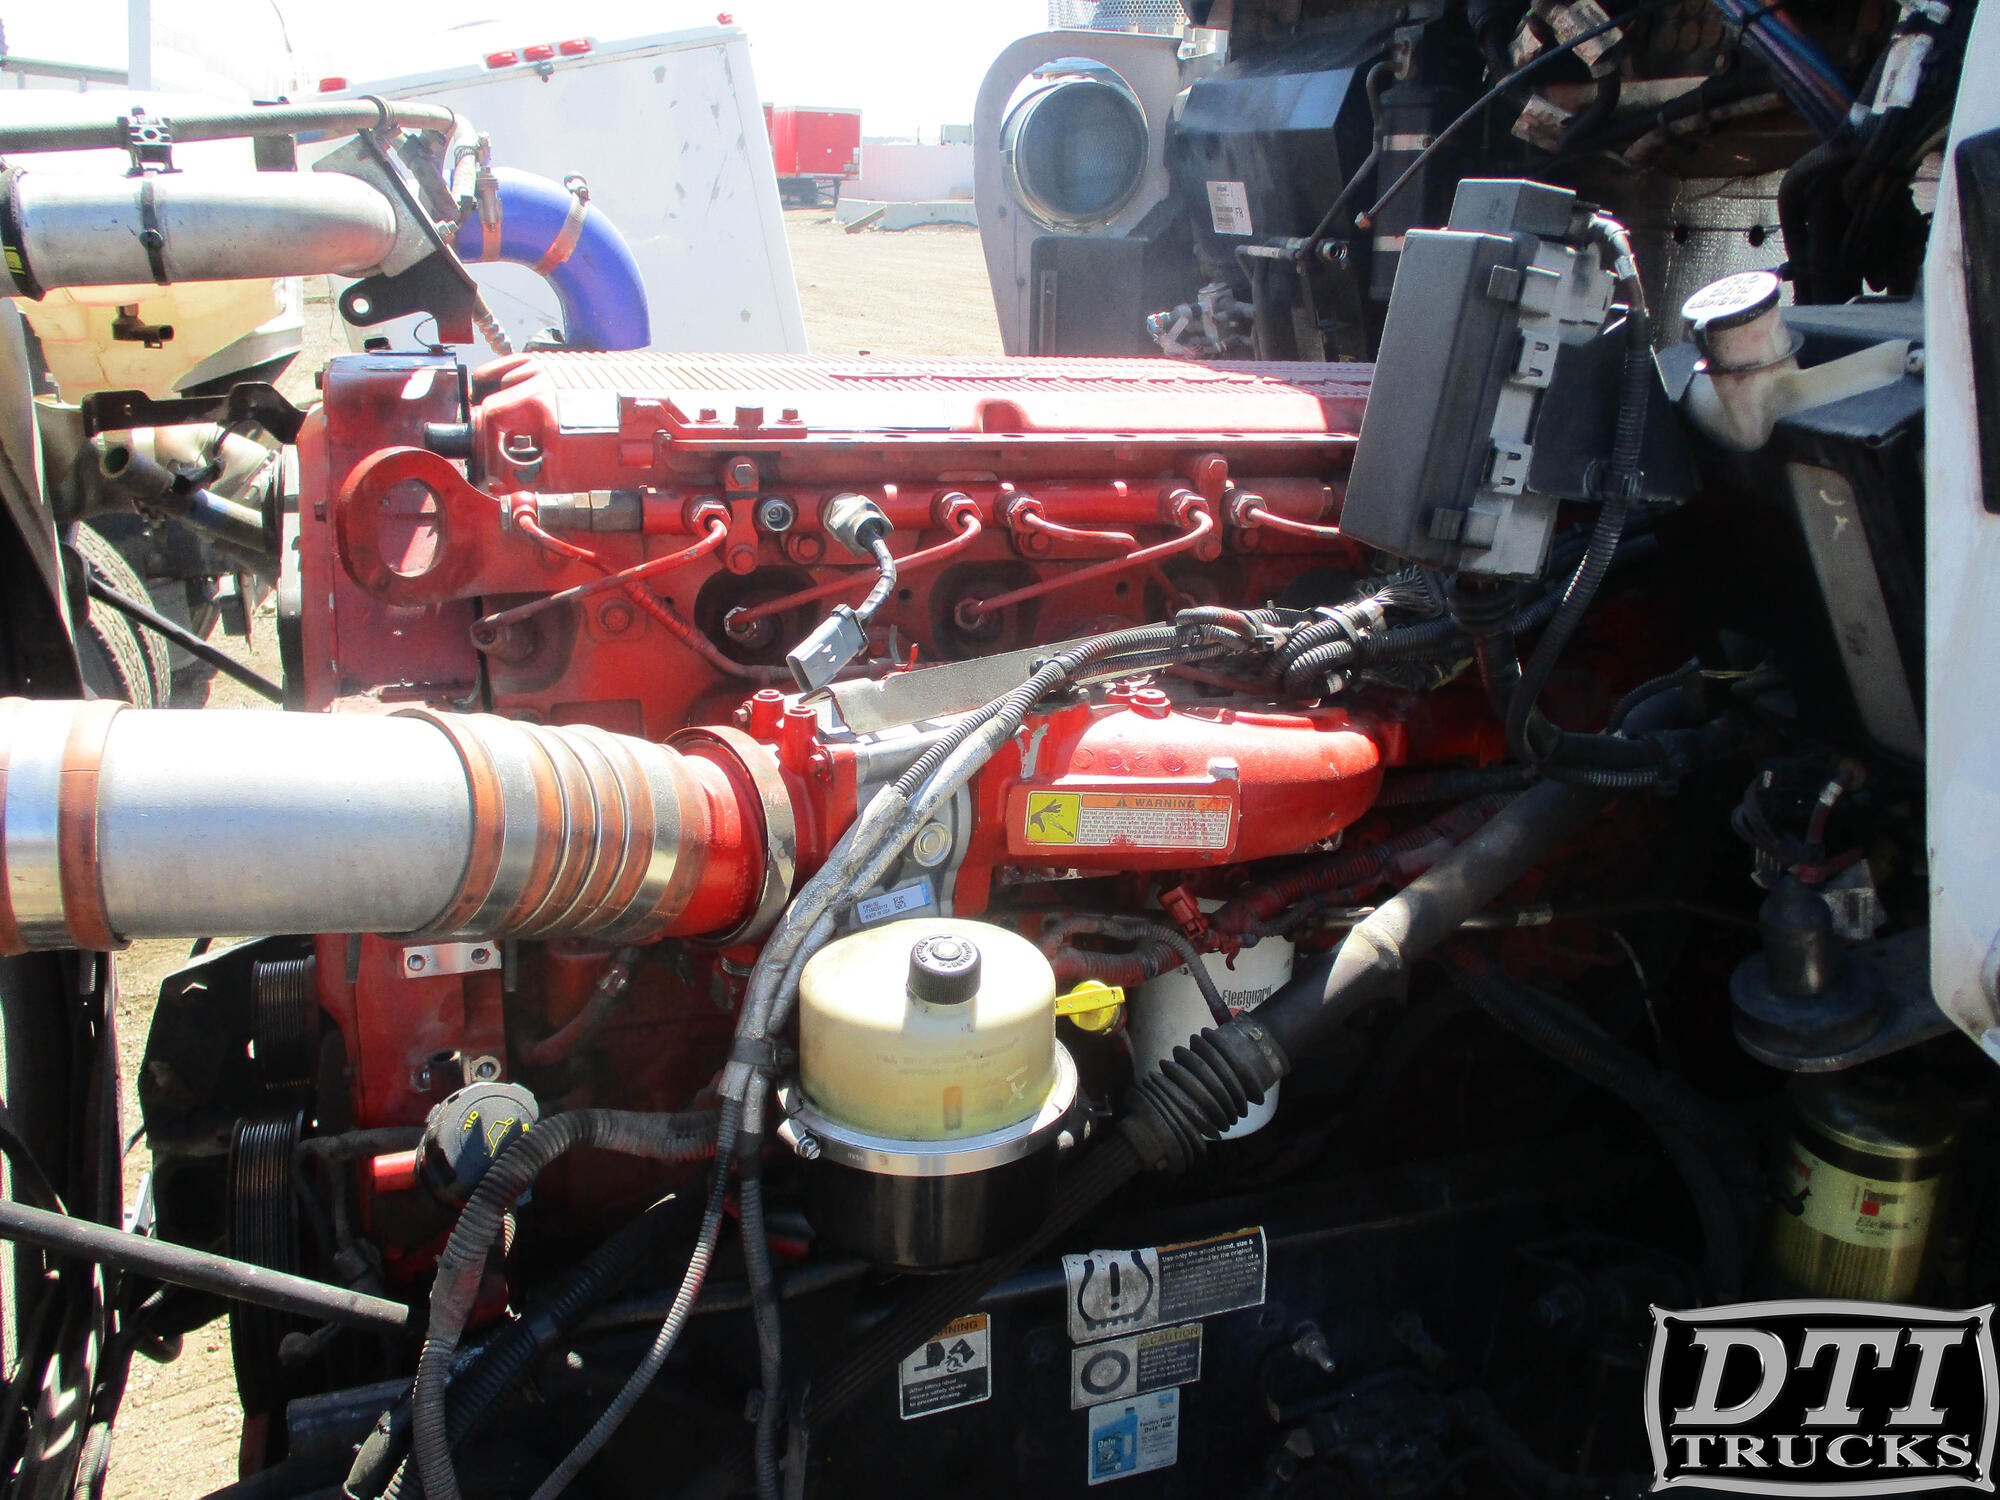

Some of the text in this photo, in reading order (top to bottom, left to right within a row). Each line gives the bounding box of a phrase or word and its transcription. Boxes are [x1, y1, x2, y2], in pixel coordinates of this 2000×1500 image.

[1135, 798, 1195, 808] WARNING
[1222, 984, 1273, 1008] Fleetguard
[463, 1110, 480, 1131] OIL
[1216, 1243, 1235, 1252] brand,
[1150, 1327, 1199, 1345] CAUTION
[1097, 1438, 1116, 1449] Delo
